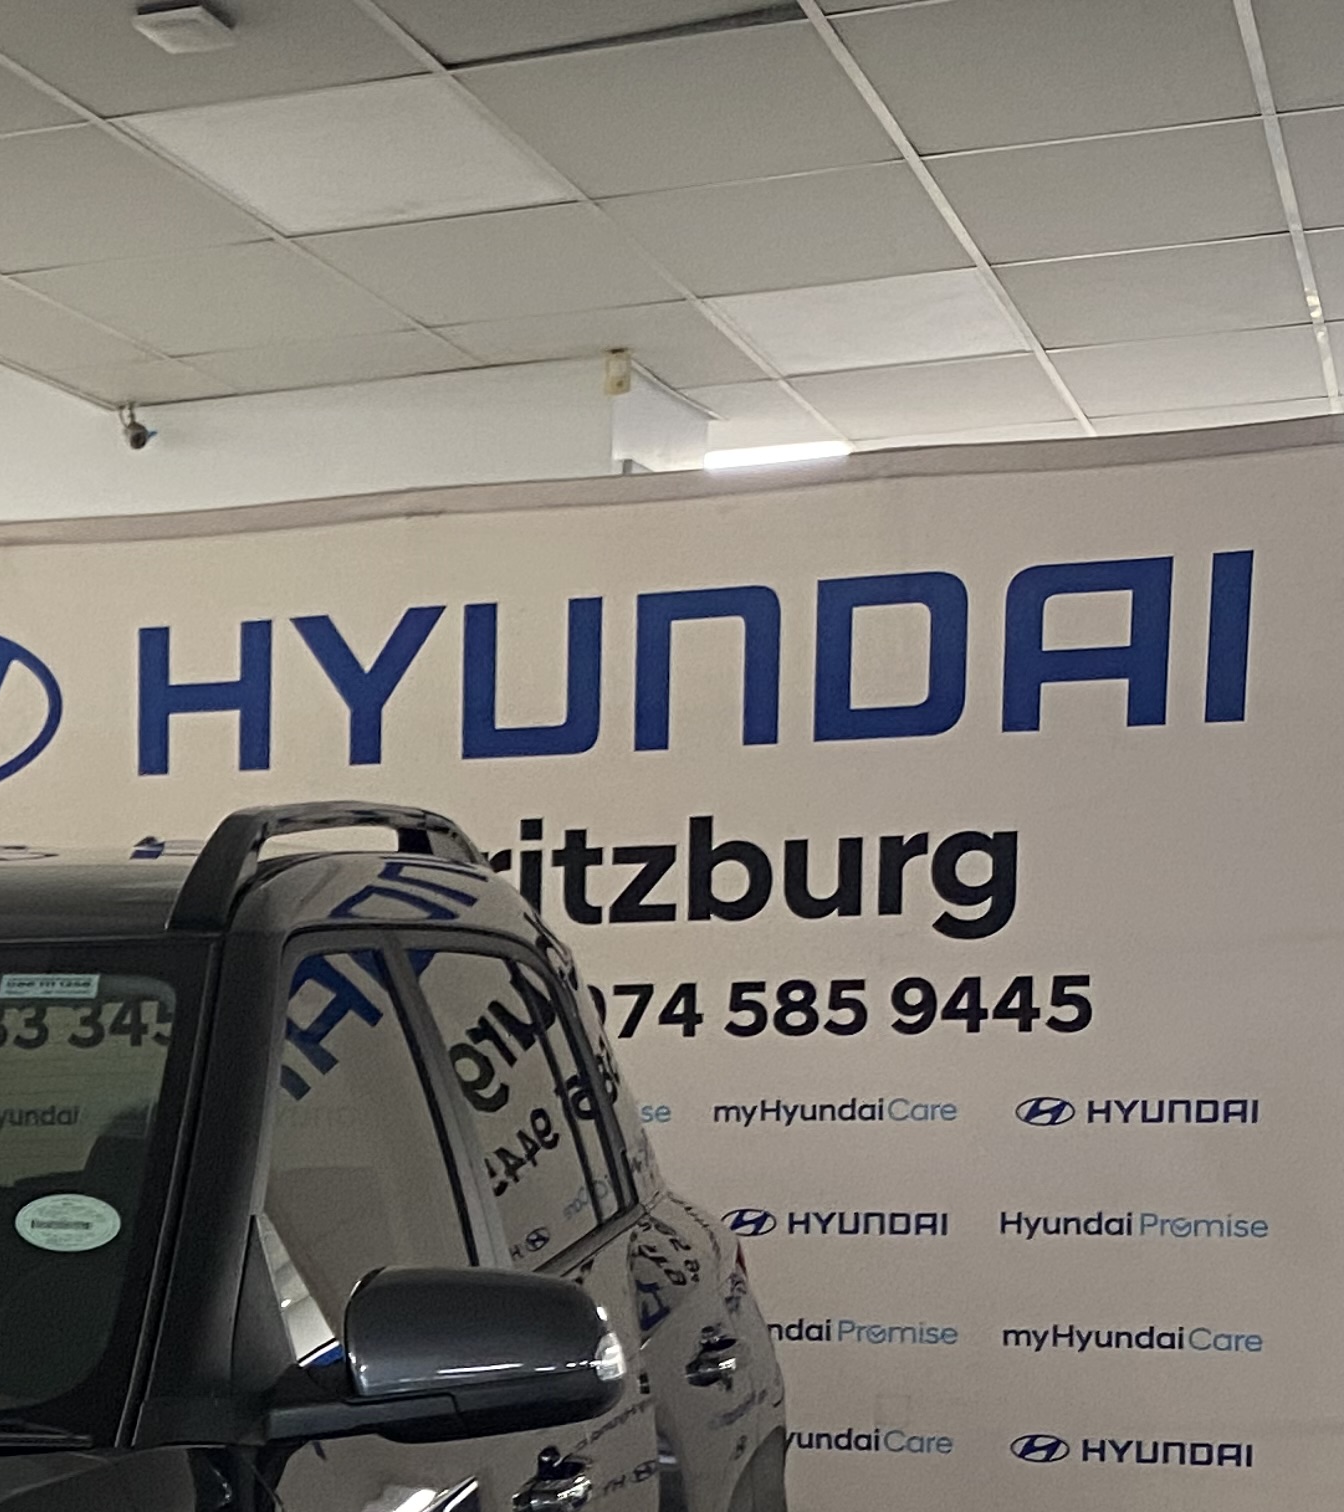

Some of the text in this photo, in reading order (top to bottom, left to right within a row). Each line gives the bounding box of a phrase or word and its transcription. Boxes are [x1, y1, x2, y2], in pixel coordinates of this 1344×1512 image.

[139, 549, 1255, 776] HYUNDAI
[588, 974, 1094, 1039] 74 585 9445
[1087, 1099, 1259, 1125] HYUNDAI
[787, 1211, 949, 1237] HYUNDAI
[1000, 1211, 1269, 1241] Hyundai Promise
[768, 1318, 959, 1345] ndai Promise
[1081, 1438, 1254, 1468] HYUNDAI
